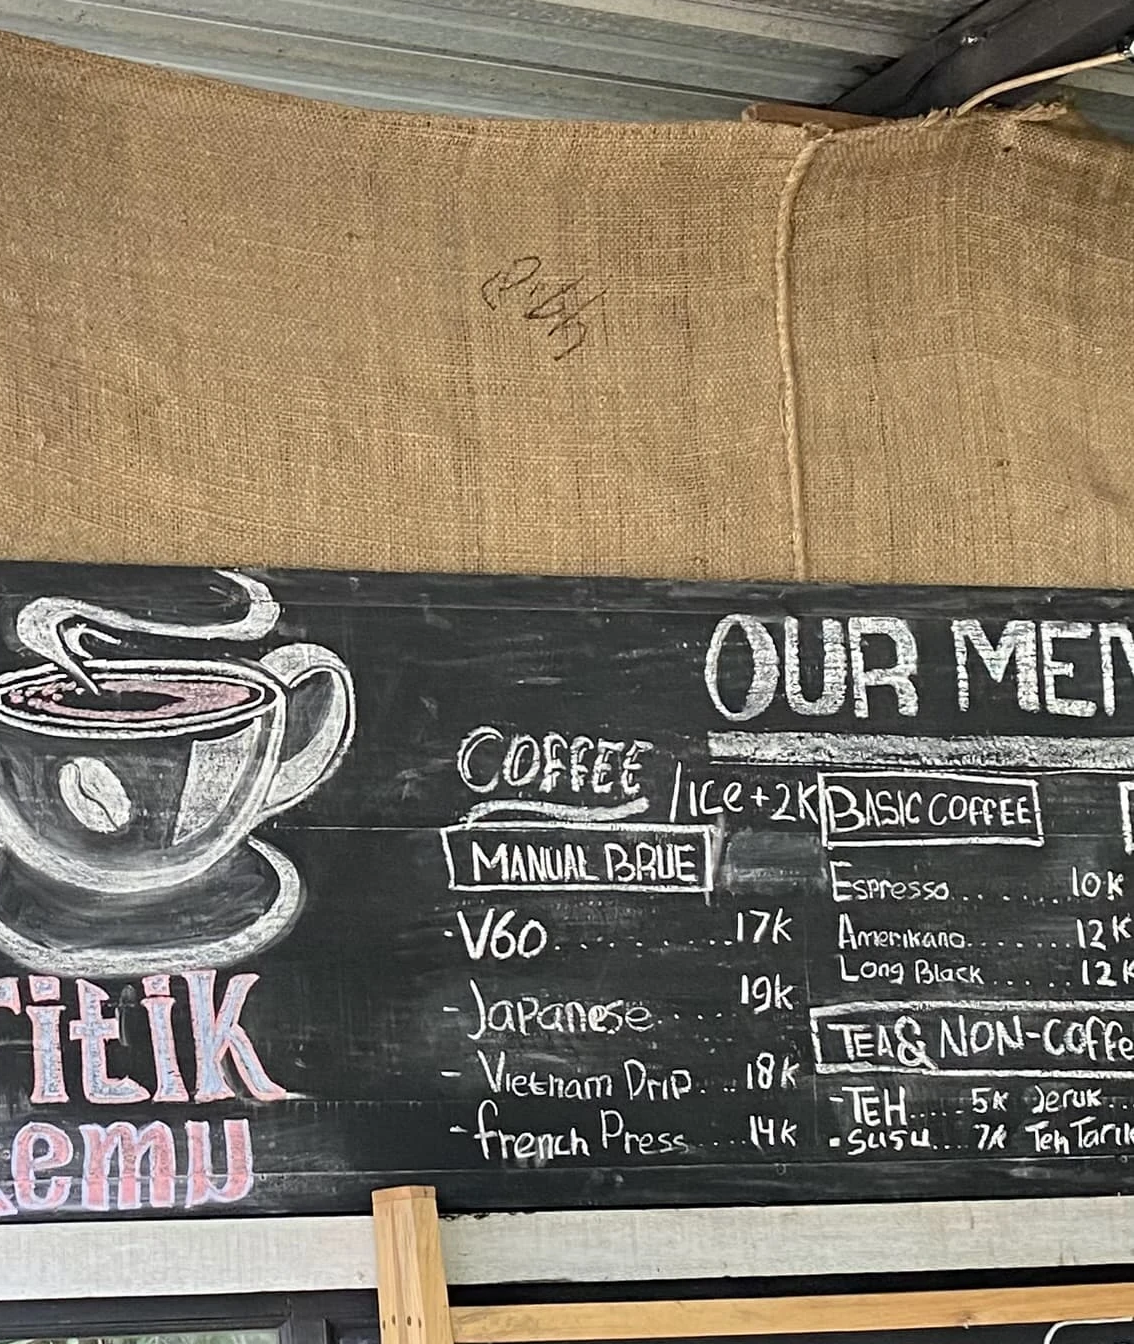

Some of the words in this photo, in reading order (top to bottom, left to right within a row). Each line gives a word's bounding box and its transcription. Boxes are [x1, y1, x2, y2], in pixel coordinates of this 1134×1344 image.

[704, 613, 919, 722] OUR
[457, 725, 654, 794] COFFEE
[823, 784, 921, 833] BASIC
[929, 792, 1032, 827] COFFEE
[472, 841, 600, 882] MANUAL
[604, 841, 699, 882] BRUE
[456, 907, 548, 960] V60
[838, 954, 905, 985] Long
[915, 959, 985, 985] Black
[477, 1049, 613, 1099] Vietnam
[842, 1086, 907, 1126] TEH
[600, 1109, 689, 1155] Press
